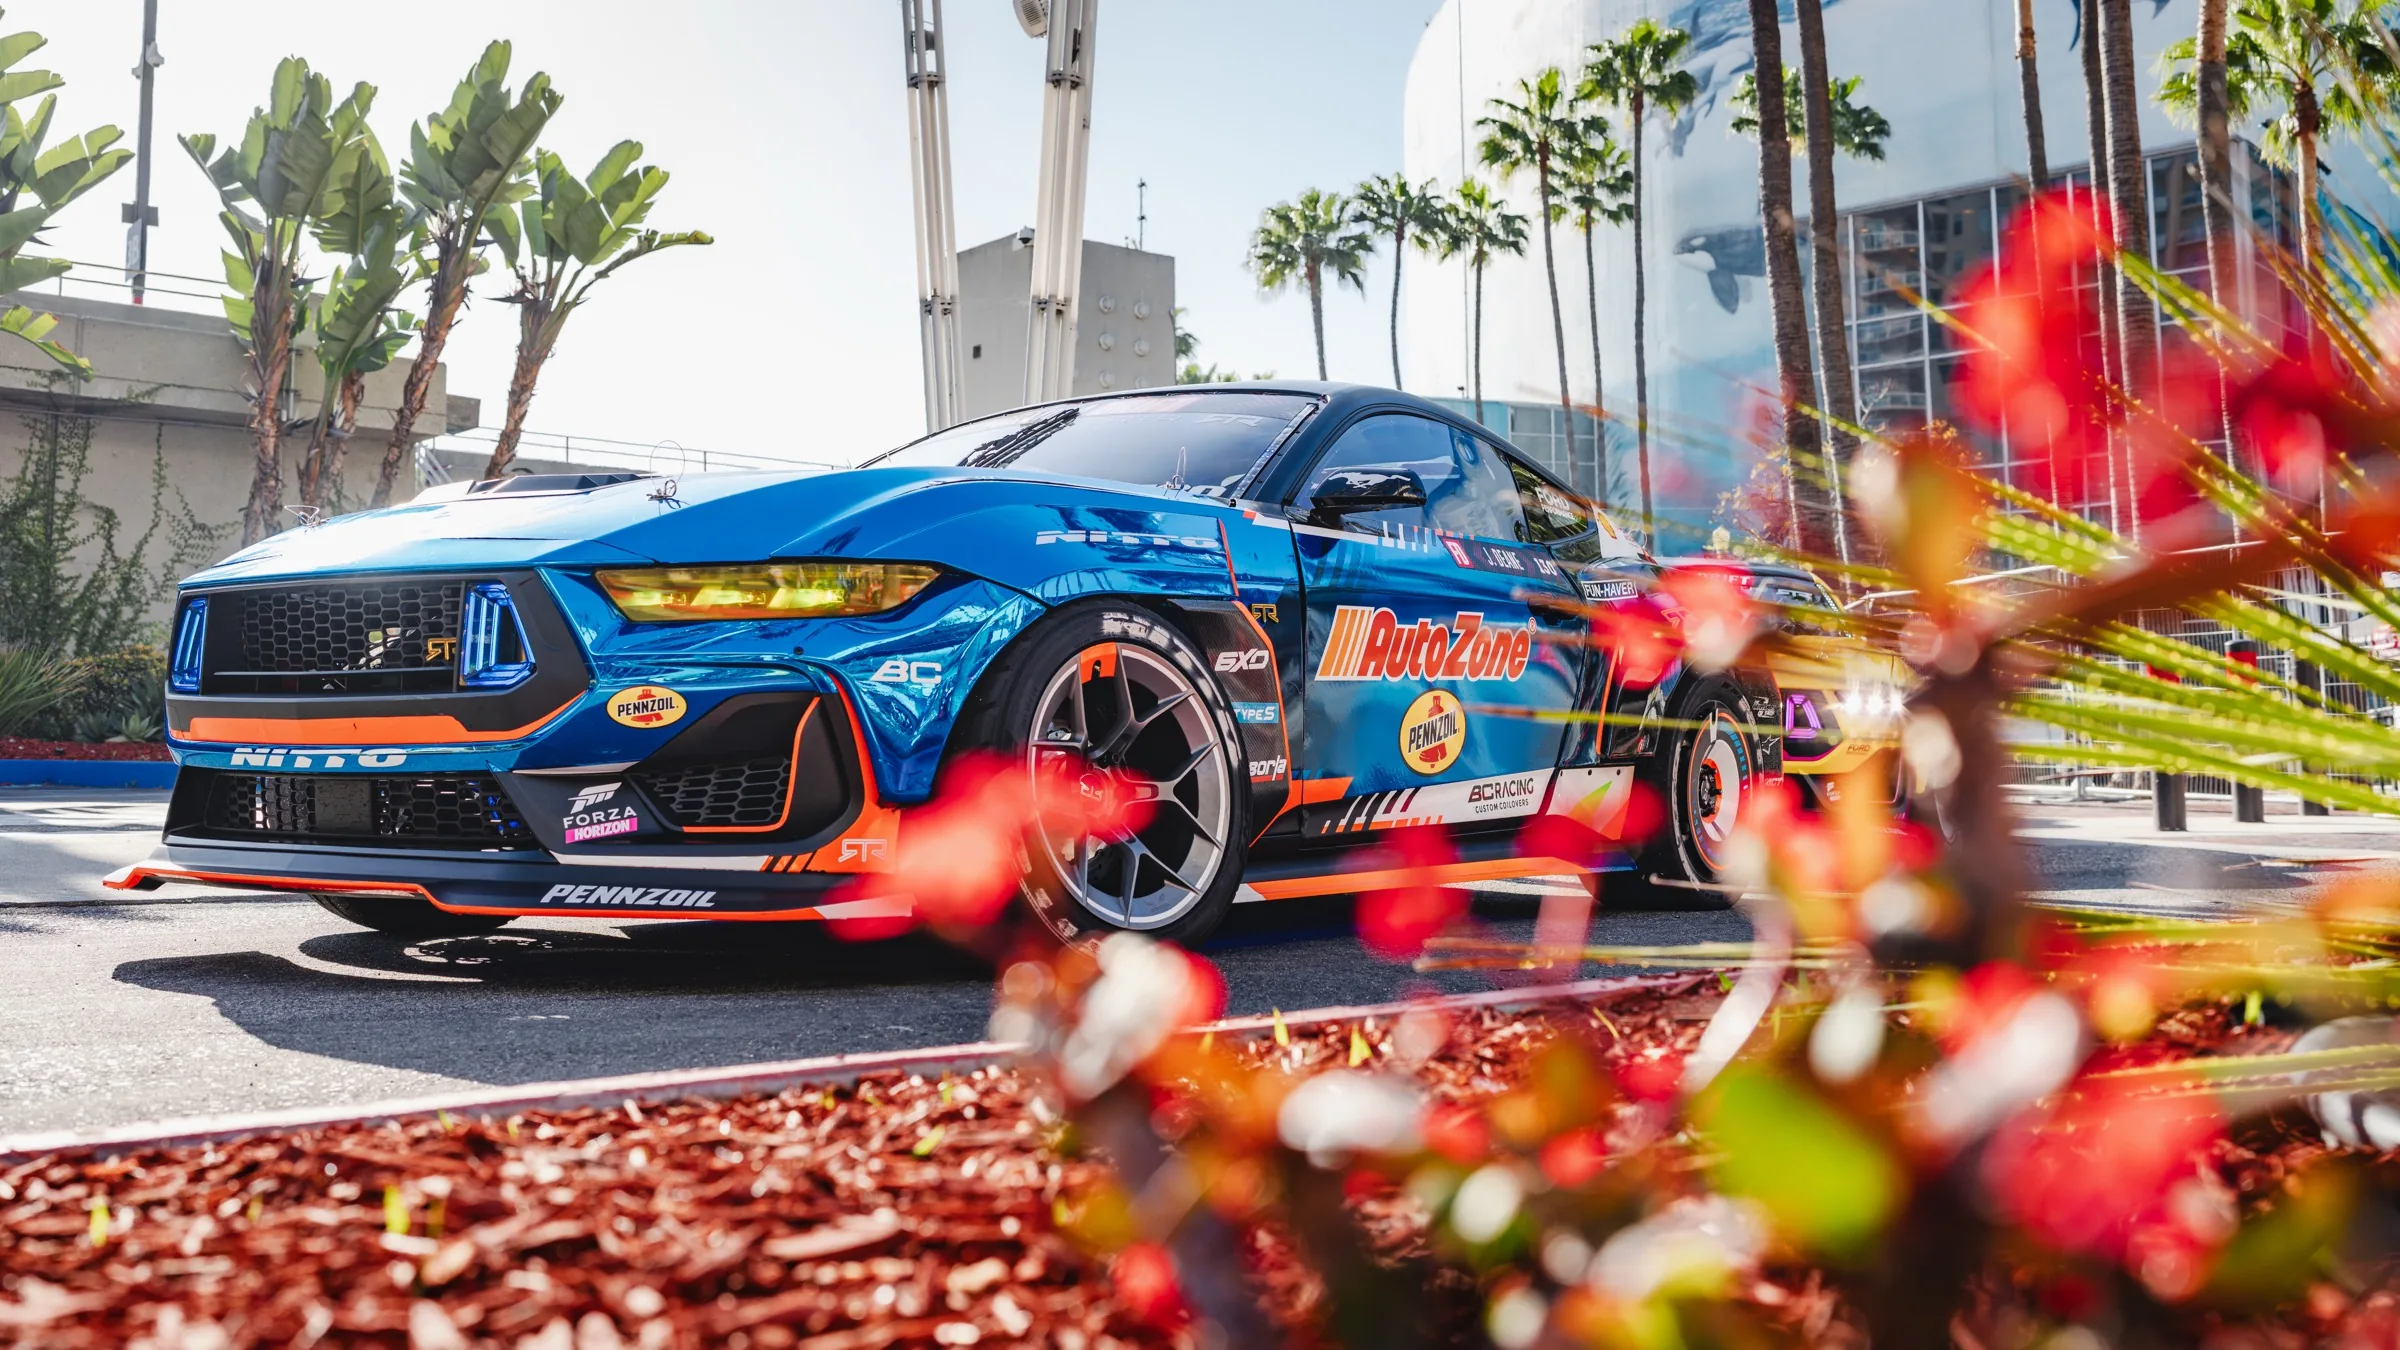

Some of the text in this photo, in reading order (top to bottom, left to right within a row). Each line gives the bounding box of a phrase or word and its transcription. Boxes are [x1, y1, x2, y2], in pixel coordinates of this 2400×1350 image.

[1036, 530, 1220, 548] NITTO
[1585, 581, 1635, 597] FUN-HAVER
[1356, 606, 1532, 683] AutoZone
[869, 660, 943, 685] BC
[617, 696, 677, 718] PENNZOIL
[1408, 710, 1460, 754] PENNZOIL
[230, 747, 407, 768] NITTO
[563, 806, 637, 829] FORZA
[1475, 799, 1529, 814] CUSTOM COILOVERS
[574, 819, 630, 841] HORIZON
[540, 884, 716, 908] PENNZOIL
